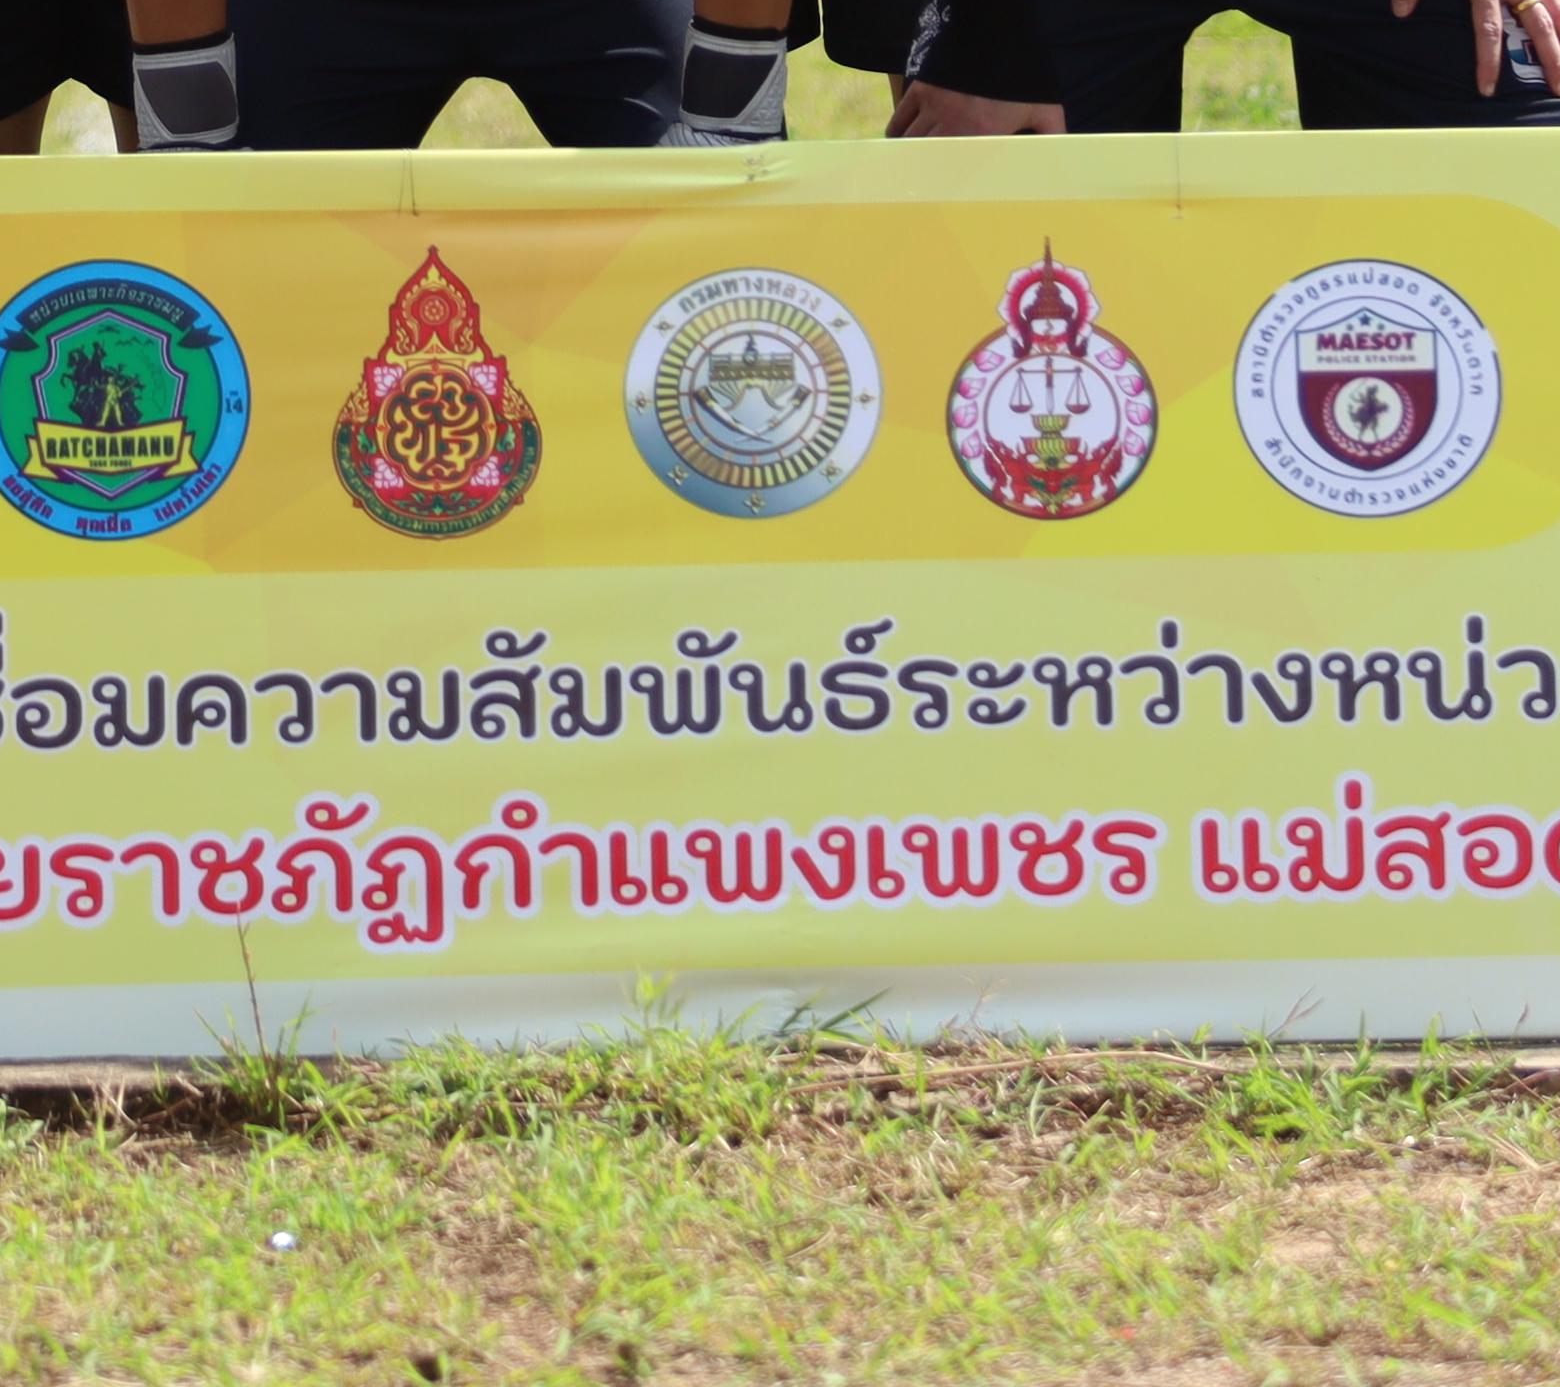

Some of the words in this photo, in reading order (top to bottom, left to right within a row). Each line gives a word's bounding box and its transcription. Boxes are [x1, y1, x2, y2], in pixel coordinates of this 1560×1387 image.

[678, 271, 822, 316] กรมทางหลวง
[1316, 332, 1417, 352] MAESOT
[46, 435, 175, 460] RATCHAMANU
